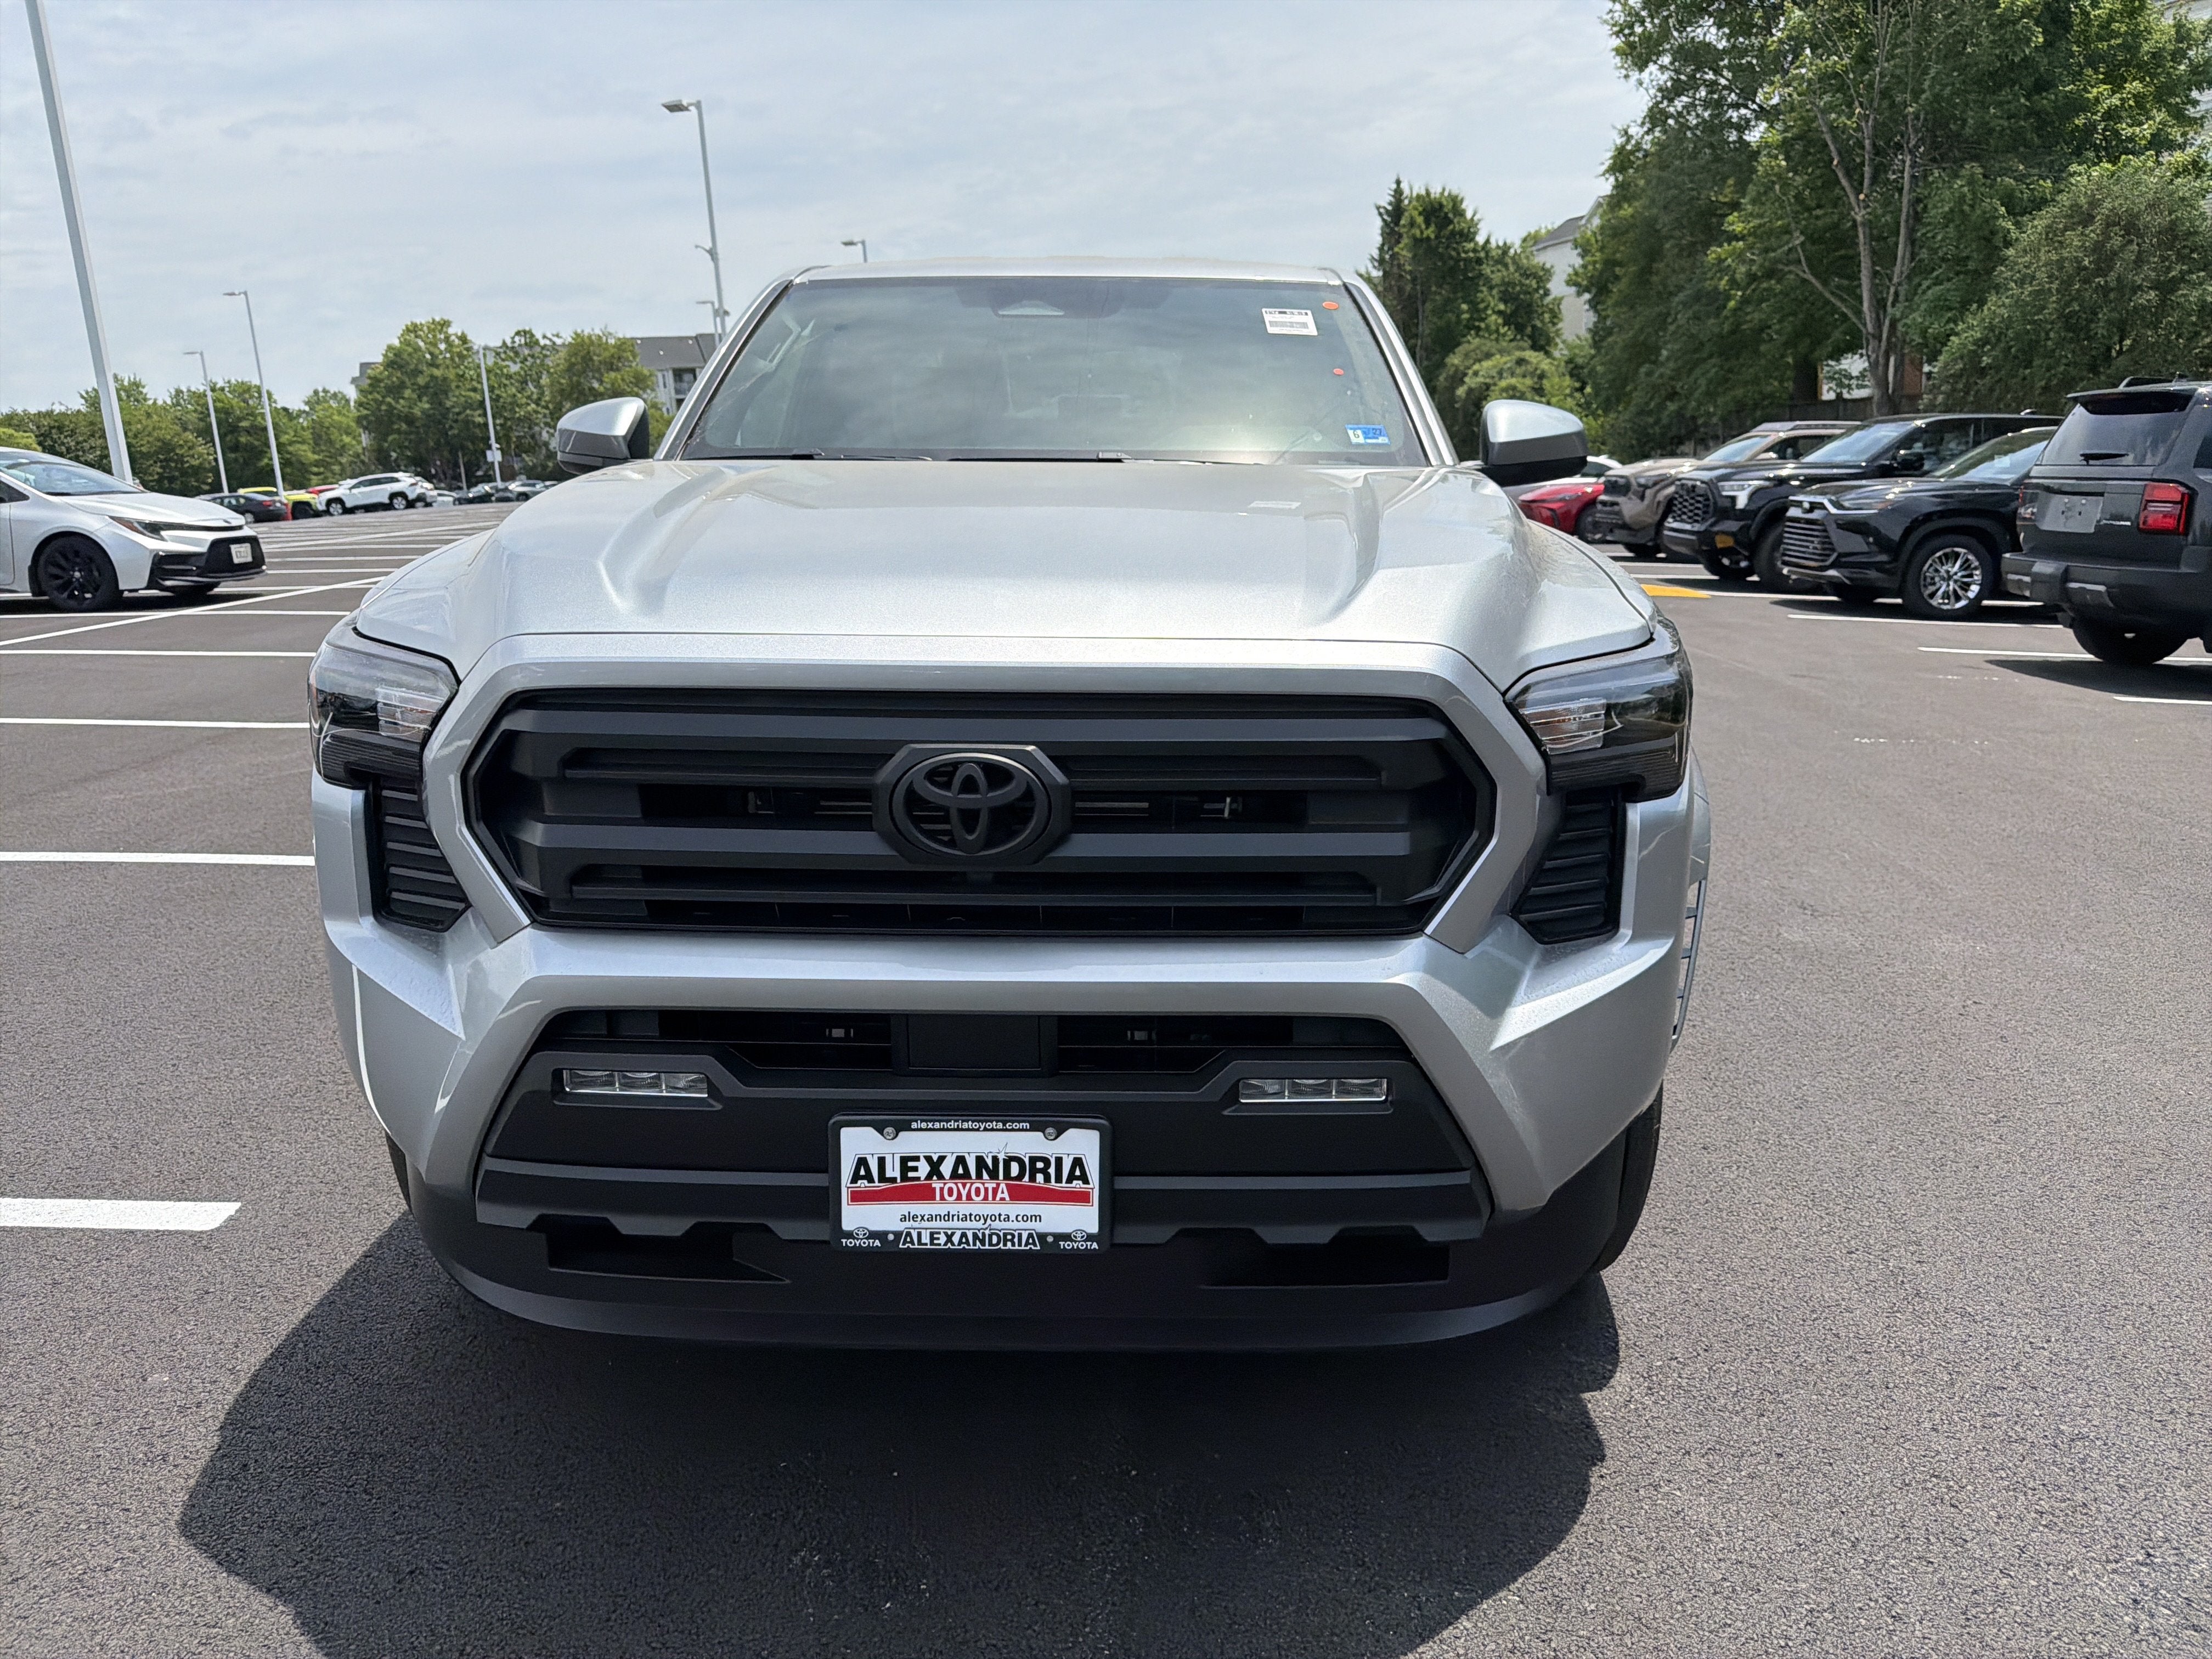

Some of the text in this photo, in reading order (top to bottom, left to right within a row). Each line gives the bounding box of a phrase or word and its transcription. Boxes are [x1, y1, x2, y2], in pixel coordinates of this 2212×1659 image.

[1353, 430, 1360, 439] 6
[911, 1120, 1030, 1131] alexandriatoyota.com
[848, 1154, 1092, 1185] ALEXANDRIA
[932, 1183, 1010, 1201] TOYOTA
[899, 1211, 1042, 1225] alexandriatoyota.com
[841, 1239, 881, 1248] TOYOTA
[899, 1229, 1040, 1249] ALEXANDRIA
[1059, 1242, 1099, 1250] TOYOTA
